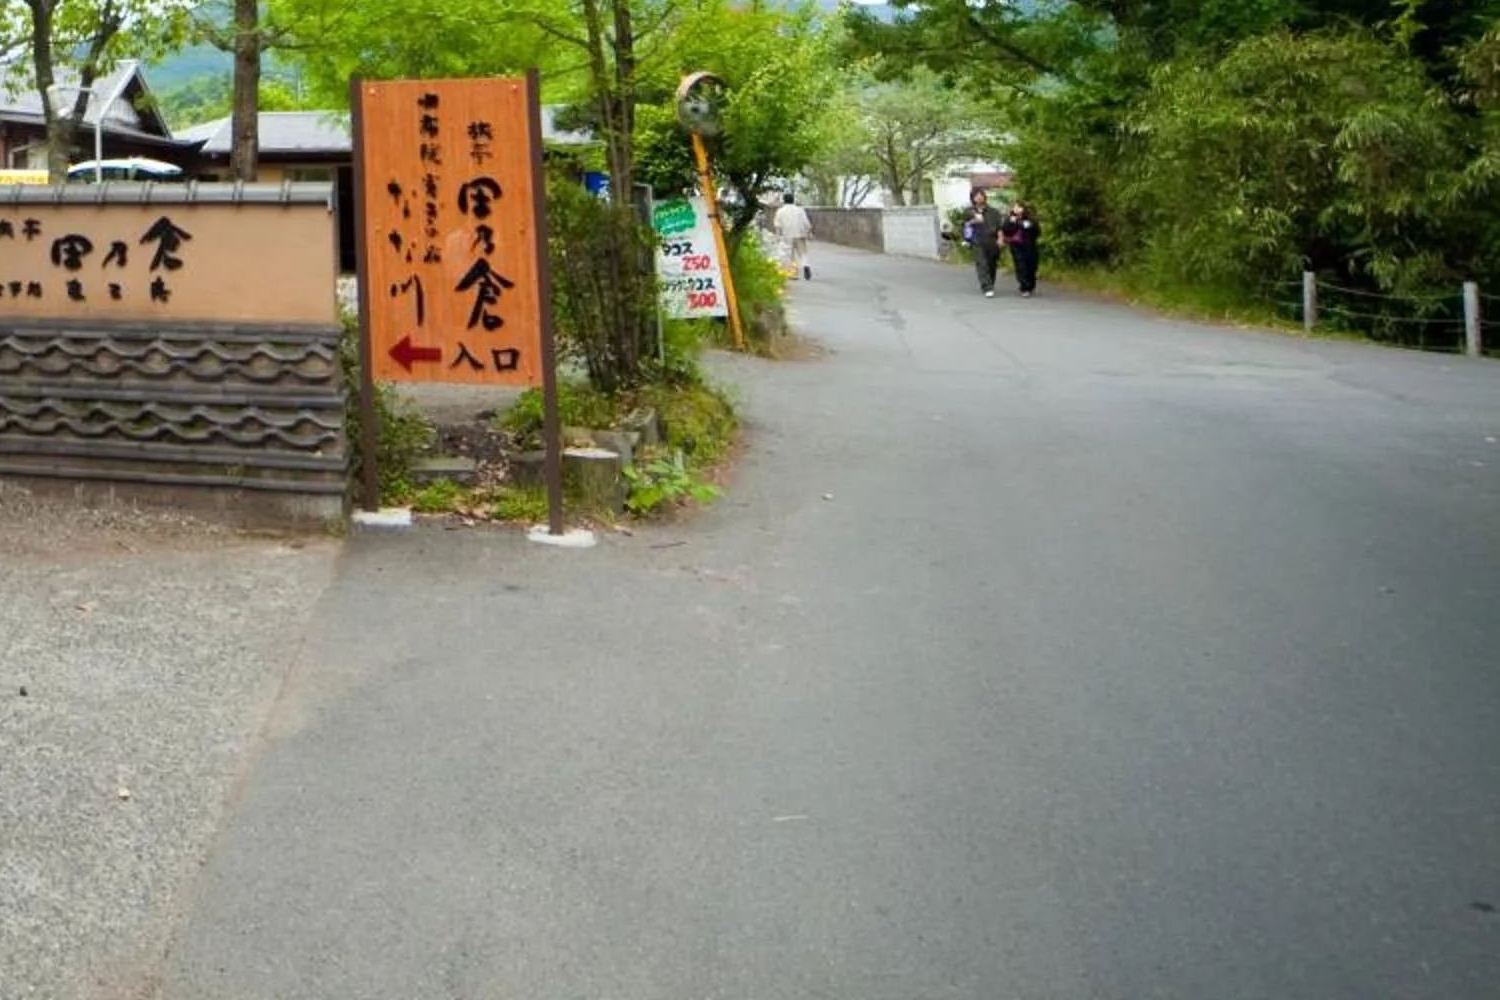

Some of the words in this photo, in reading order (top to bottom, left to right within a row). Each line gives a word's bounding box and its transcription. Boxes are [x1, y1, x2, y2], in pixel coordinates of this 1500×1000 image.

[49, 215, 193, 272] 田乃倉
[454, 176, 515, 332] 田乃倉
[682, 255, 711, 271] 250
[450, 342, 520, 373] 入口
